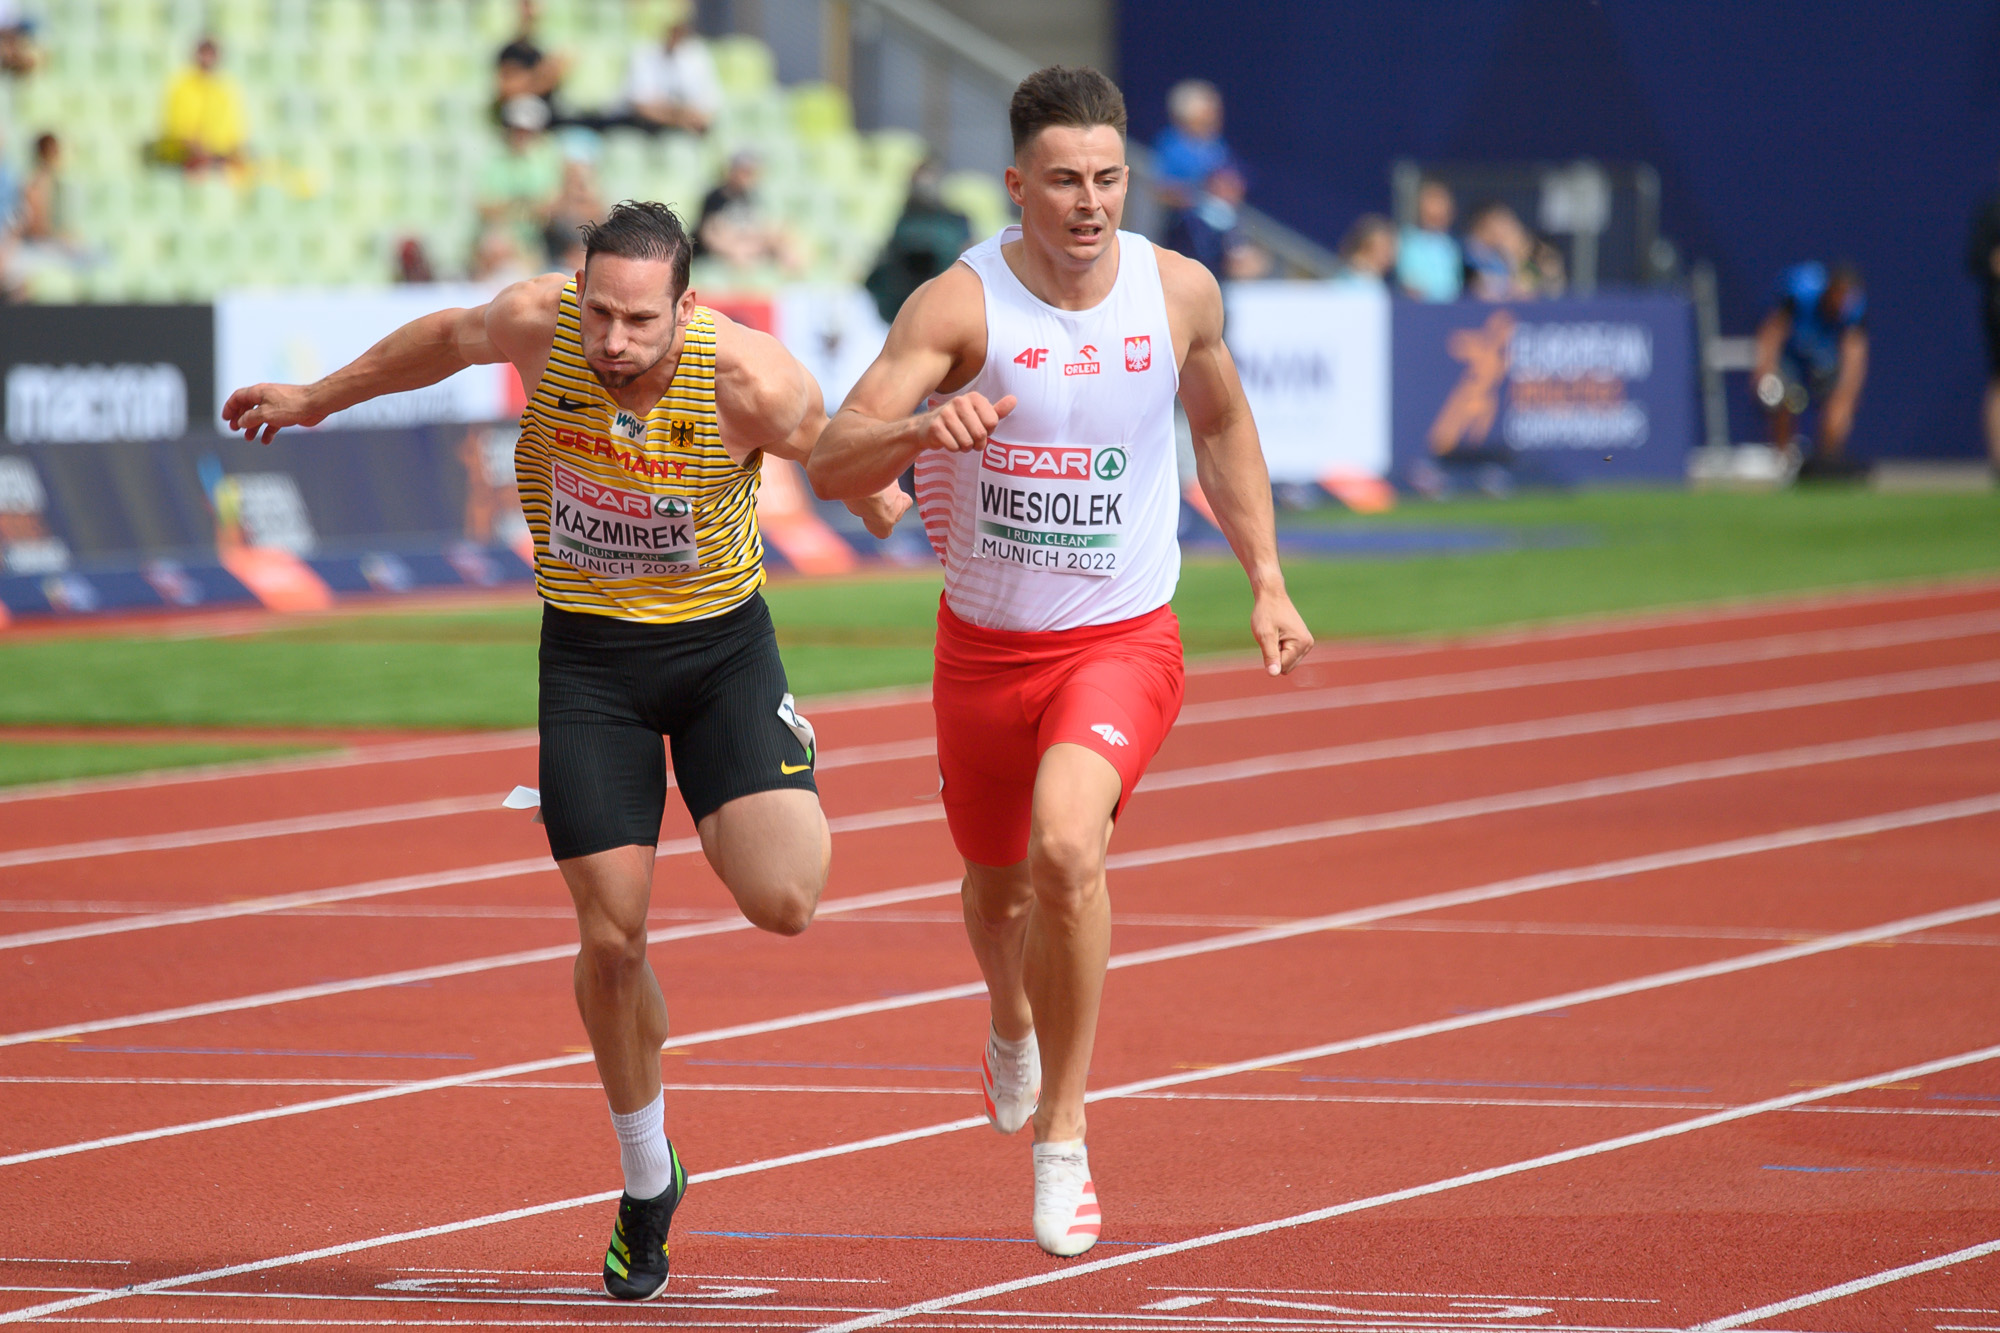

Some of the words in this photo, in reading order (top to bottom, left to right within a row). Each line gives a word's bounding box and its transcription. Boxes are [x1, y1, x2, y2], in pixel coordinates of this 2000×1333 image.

[1013, 347, 1049, 369] 4F
[1065, 363, 1099, 375] ORLEN
[555, 427, 688, 480] GERMANY
[984, 443, 1088, 476] SPAR
[556, 470, 649, 517] SPAR
[980, 480, 1123, 526] WIESIOLEK
[555, 499, 691, 550] KAZMIREK
[1014, 529, 1042, 544] RUN
[559, 548, 634, 575] MUNICH
[642, 562, 691, 574] 2022
[588, 546, 614, 559] RUN
[982, 538, 1059, 568] MUNICH
[1067, 552, 1116, 570] 2022
[1090, 724, 1129, 747] 4F
